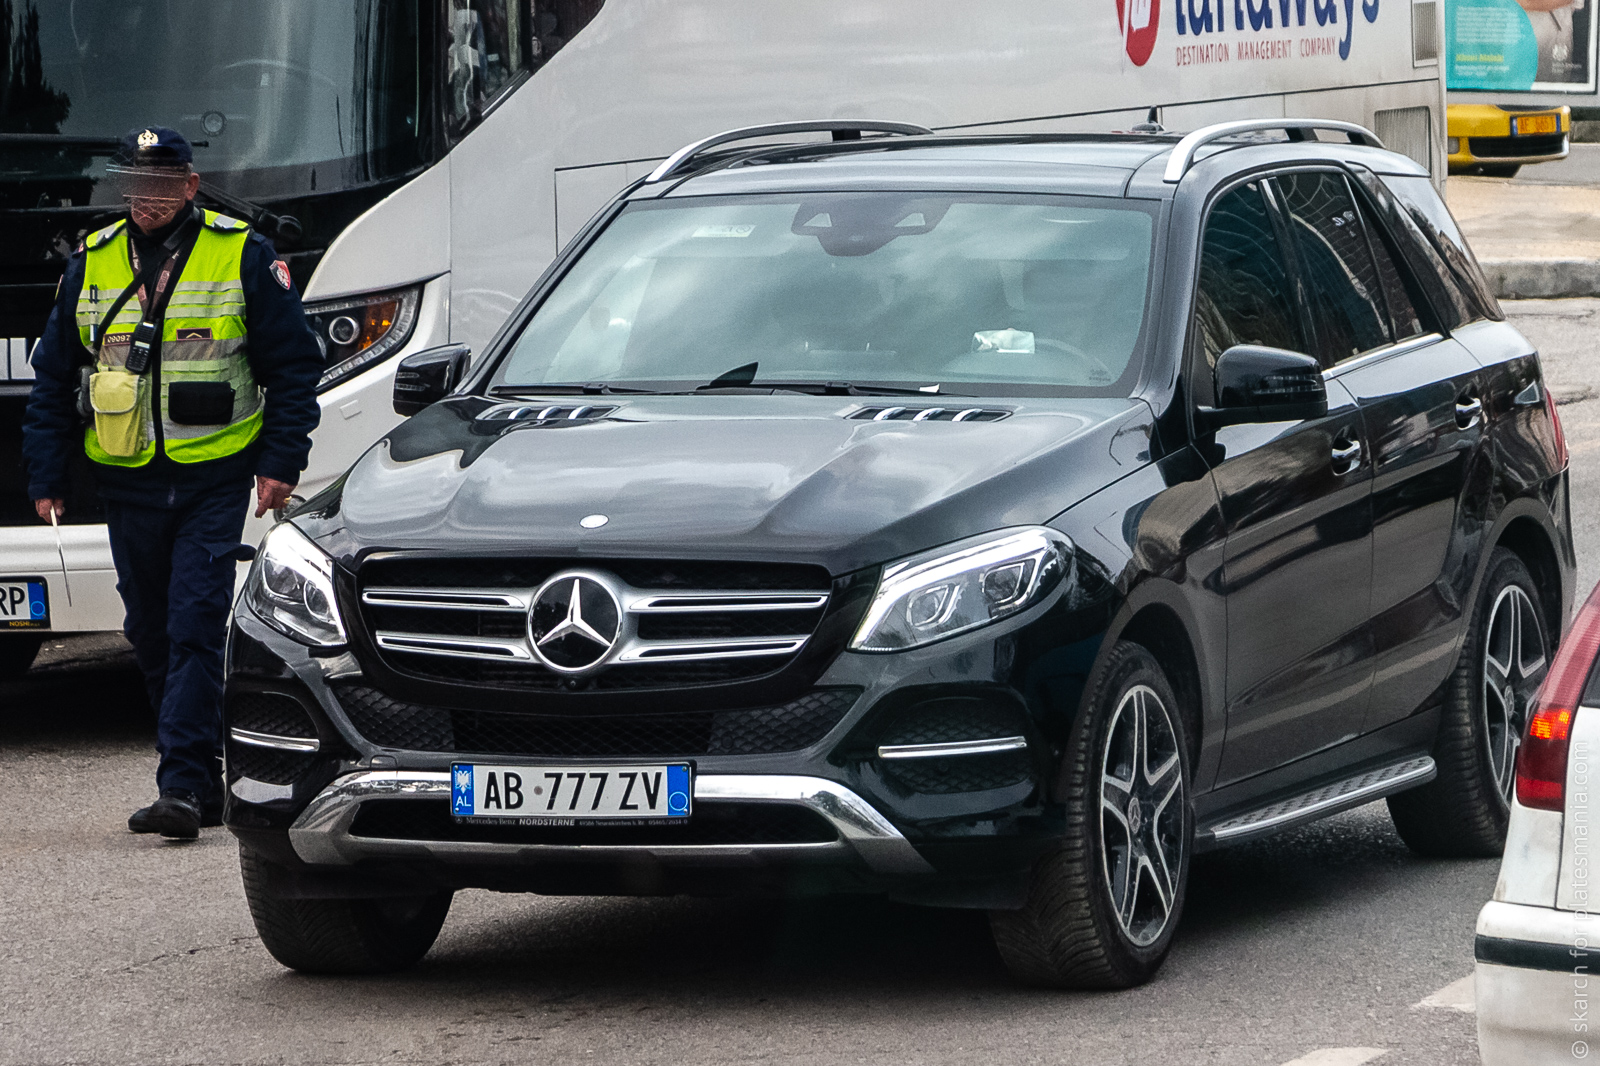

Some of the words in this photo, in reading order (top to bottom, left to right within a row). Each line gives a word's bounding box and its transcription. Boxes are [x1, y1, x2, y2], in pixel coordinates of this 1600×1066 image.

[1176, 43, 1230, 66] DESTINATION
[1237, 39, 1292, 60] MANAGEMENT
[1300, 36, 1336, 57] COMPANY
[455, 795, 472, 807] AL
[483, 771, 524, 810] AB
[544, 771, 609, 811] 777
[618, 771, 662, 811] ZV
[519, 818, 575, 826] NORDSTERNE
